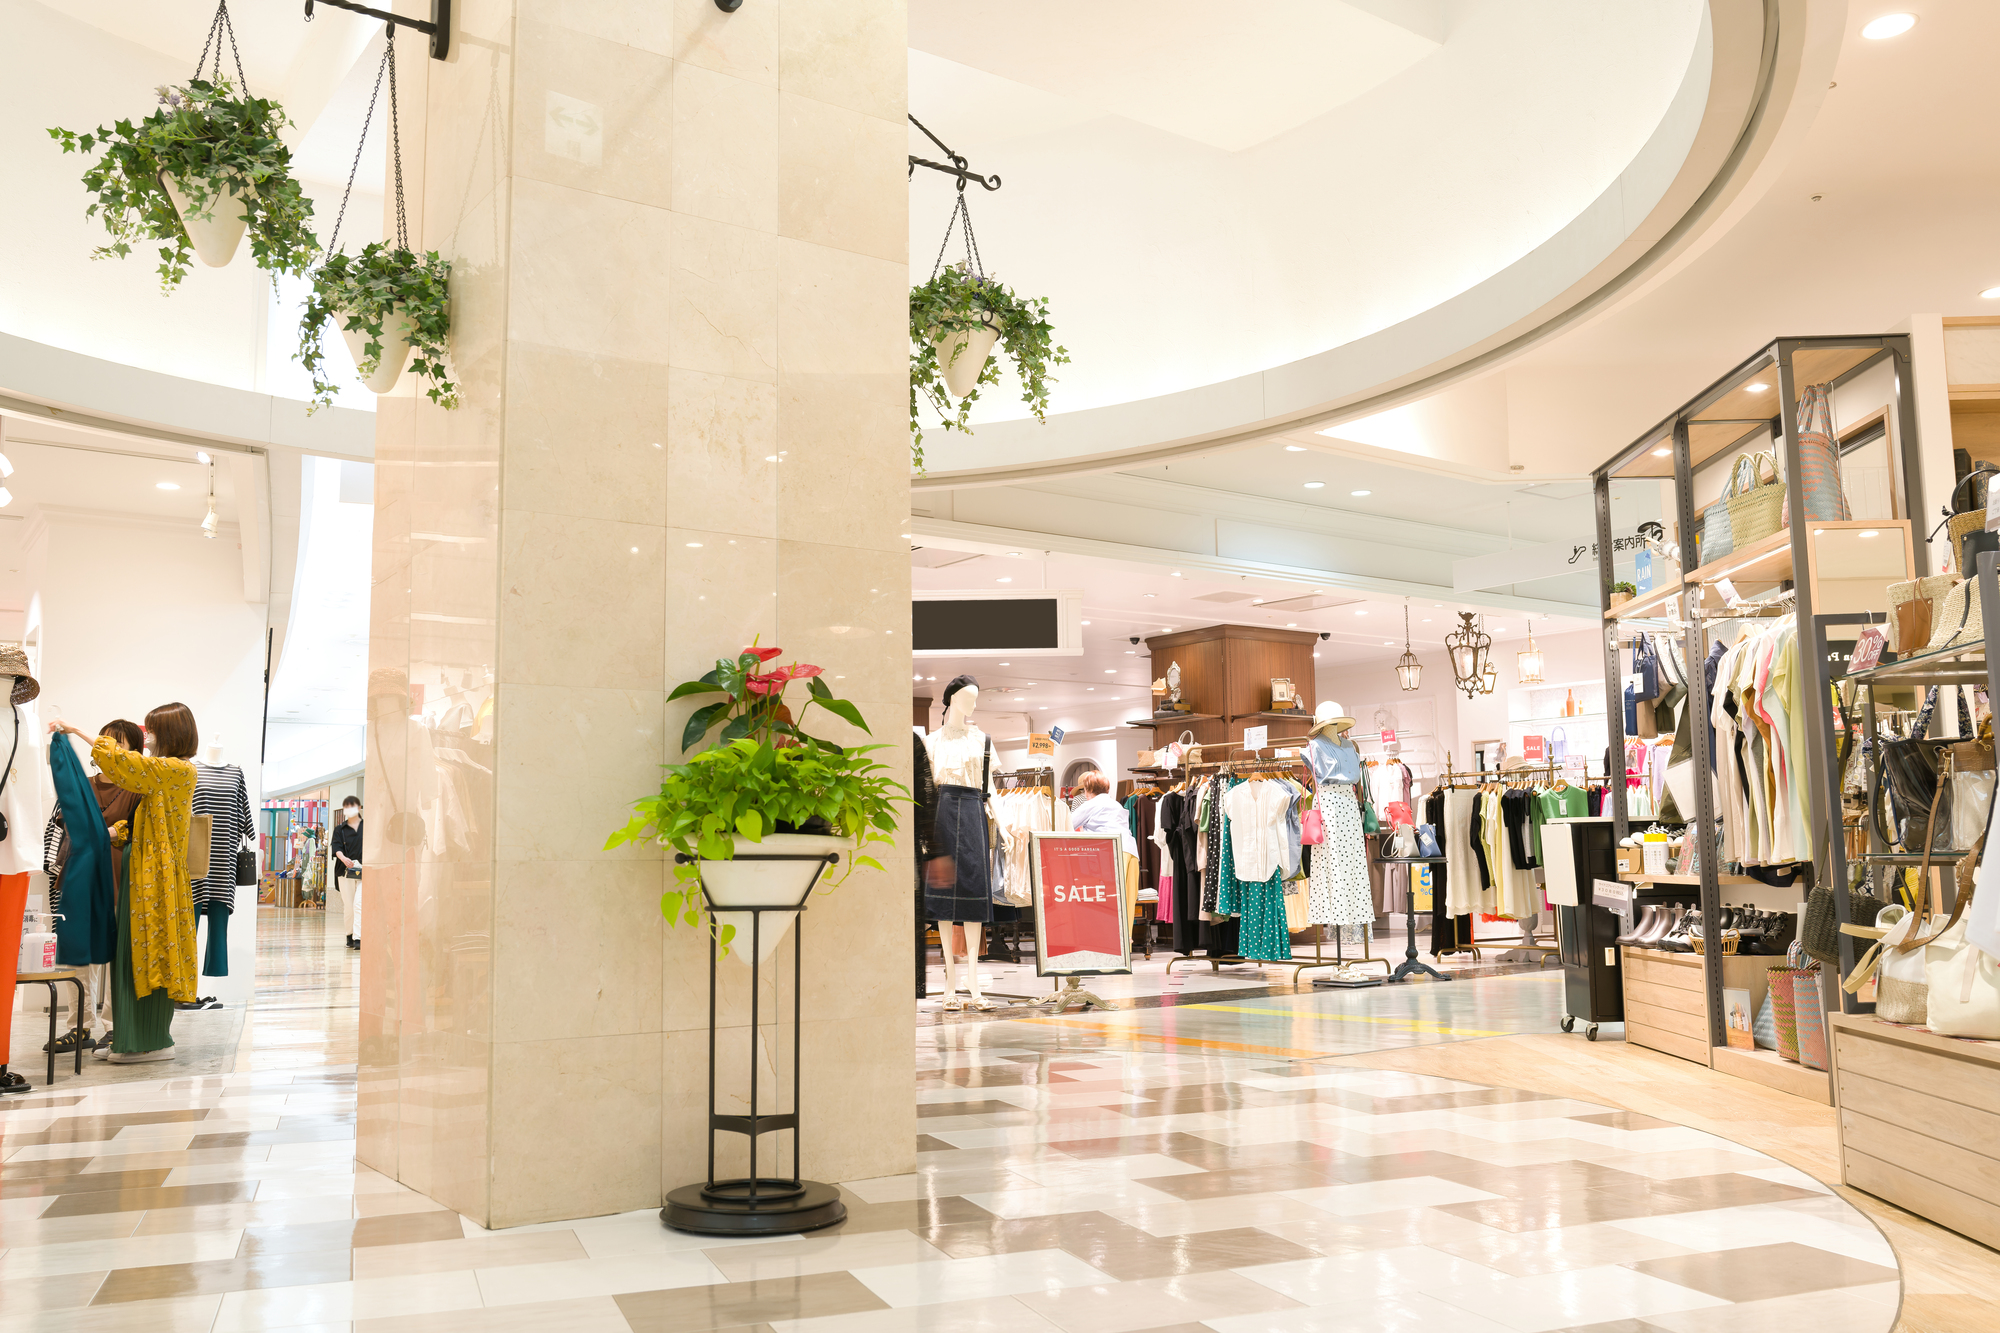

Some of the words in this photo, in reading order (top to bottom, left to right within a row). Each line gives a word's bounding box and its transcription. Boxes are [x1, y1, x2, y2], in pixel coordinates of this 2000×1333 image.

[1636, 563, 1652, 582] RAIN
[1867, 649, 1880, 661] OFF
[1054, 884, 1107, 903] SALE
